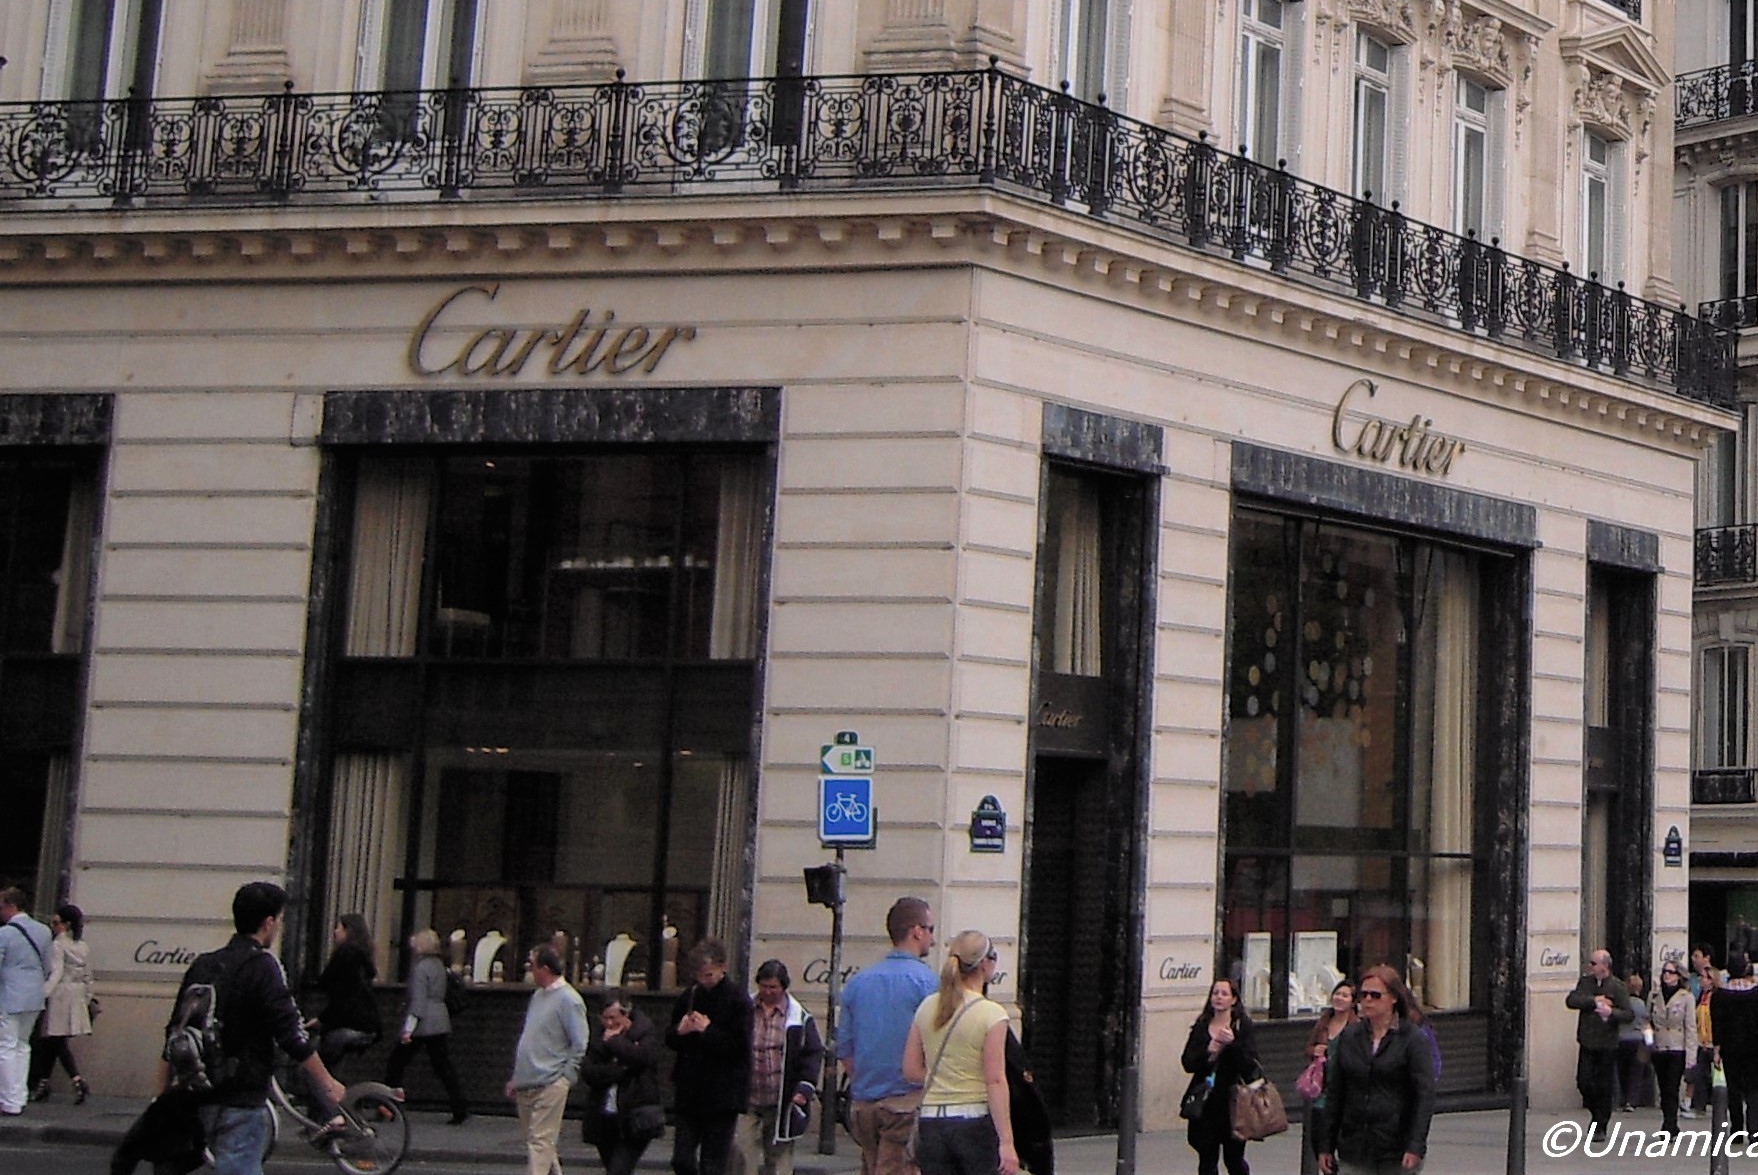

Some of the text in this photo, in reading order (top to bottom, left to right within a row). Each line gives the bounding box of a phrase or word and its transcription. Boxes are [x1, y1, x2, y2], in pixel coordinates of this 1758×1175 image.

[408, 283, 697, 375] Cartier
[1332, 378, 1466, 476] Cartier
[134, 940, 196, 964] Cartie
[1540, 947, 1571, 967] Cartier
[1160, 956, 1202, 980] Cartier
